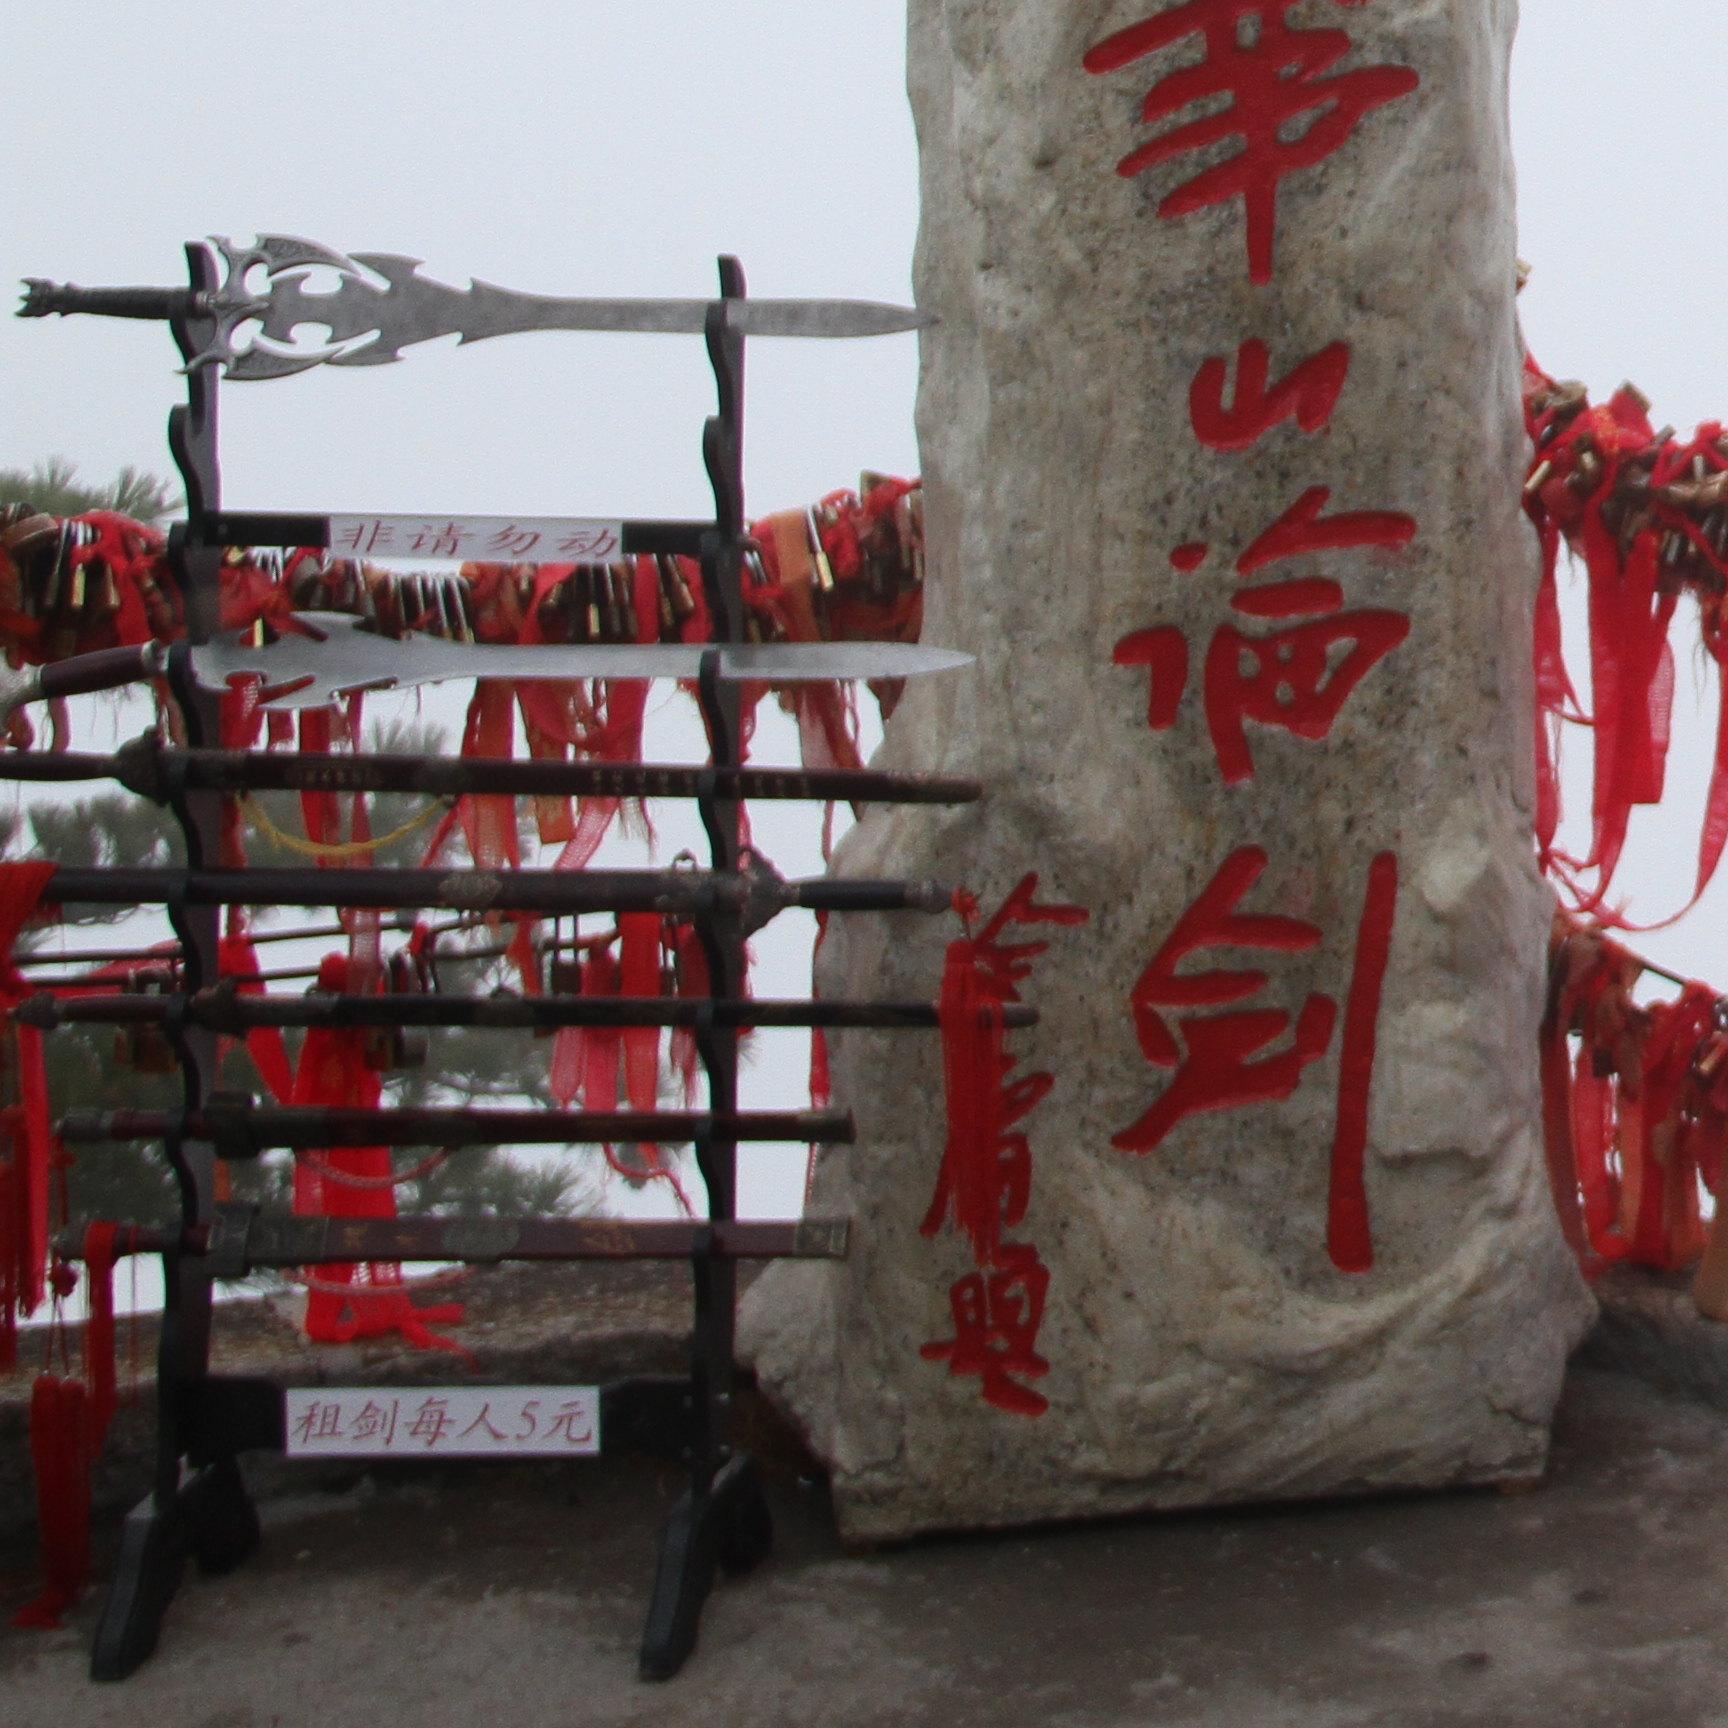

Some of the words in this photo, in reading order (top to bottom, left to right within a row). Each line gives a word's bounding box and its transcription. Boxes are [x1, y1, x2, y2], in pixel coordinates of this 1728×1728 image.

[337, 519, 618, 558] 非请勿动
[292, 1396, 592, 1447] 租剑每人5元
